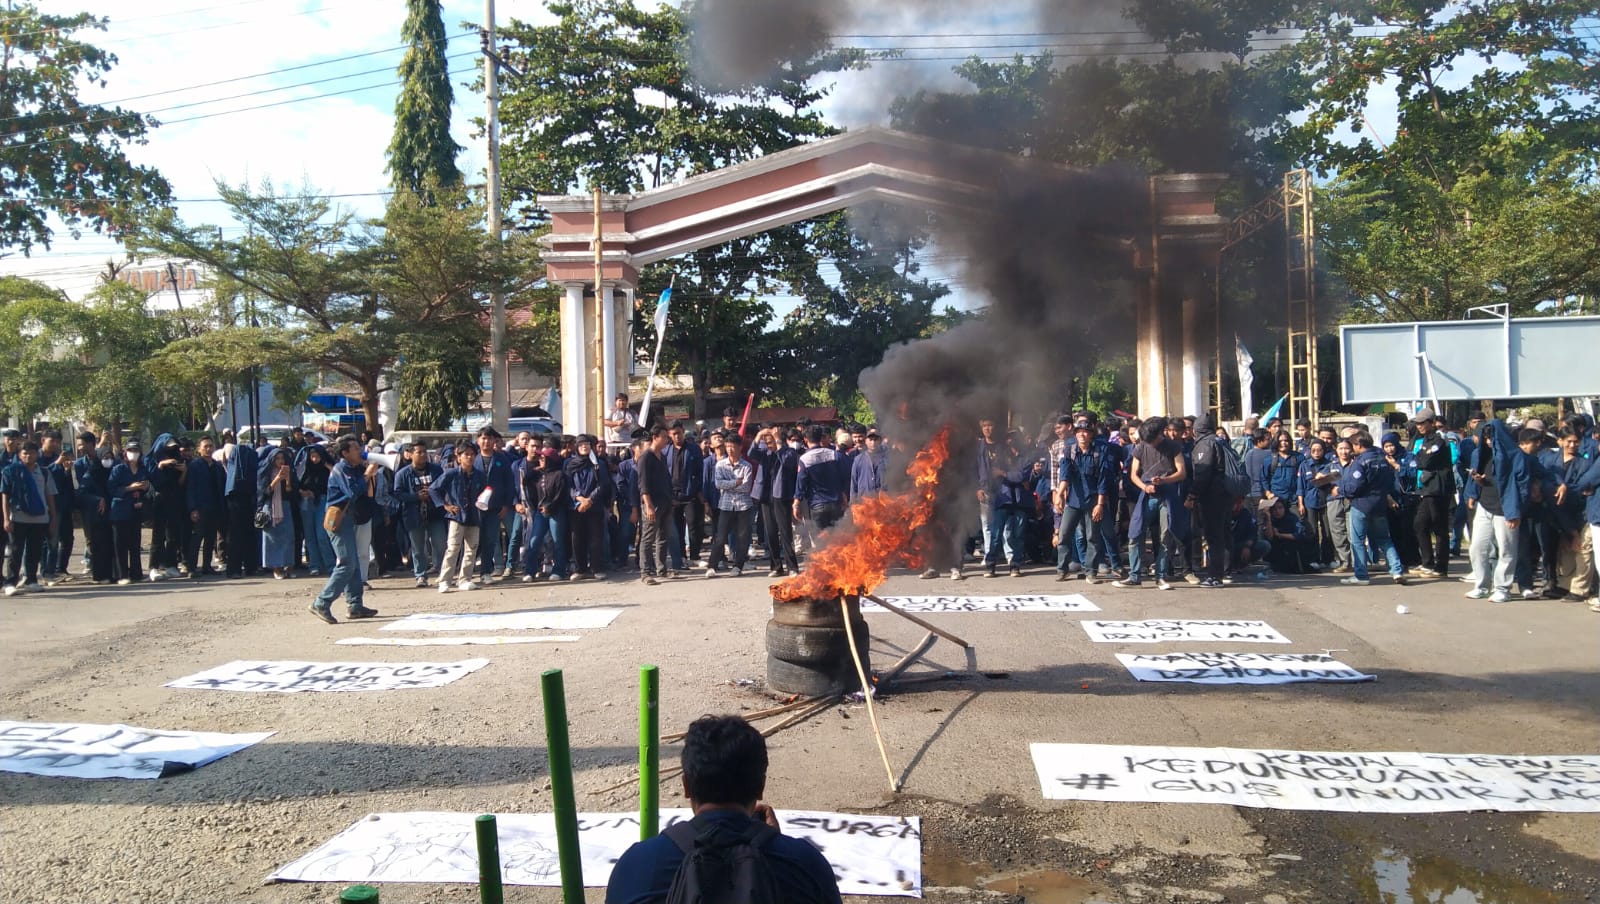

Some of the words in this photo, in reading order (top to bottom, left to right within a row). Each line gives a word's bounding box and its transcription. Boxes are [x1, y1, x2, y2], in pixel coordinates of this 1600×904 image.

[1199, 659, 1241, 667] DI
[1153, 667, 1357, 679] DZHOLIMI
[1256, 752, 1419, 768] KAWAL
[1424, 755, 1599, 769] TERUS
[1123, 756, 1483, 784] KEDUNGUAN
[785, 817, 920, 840] SURGA
